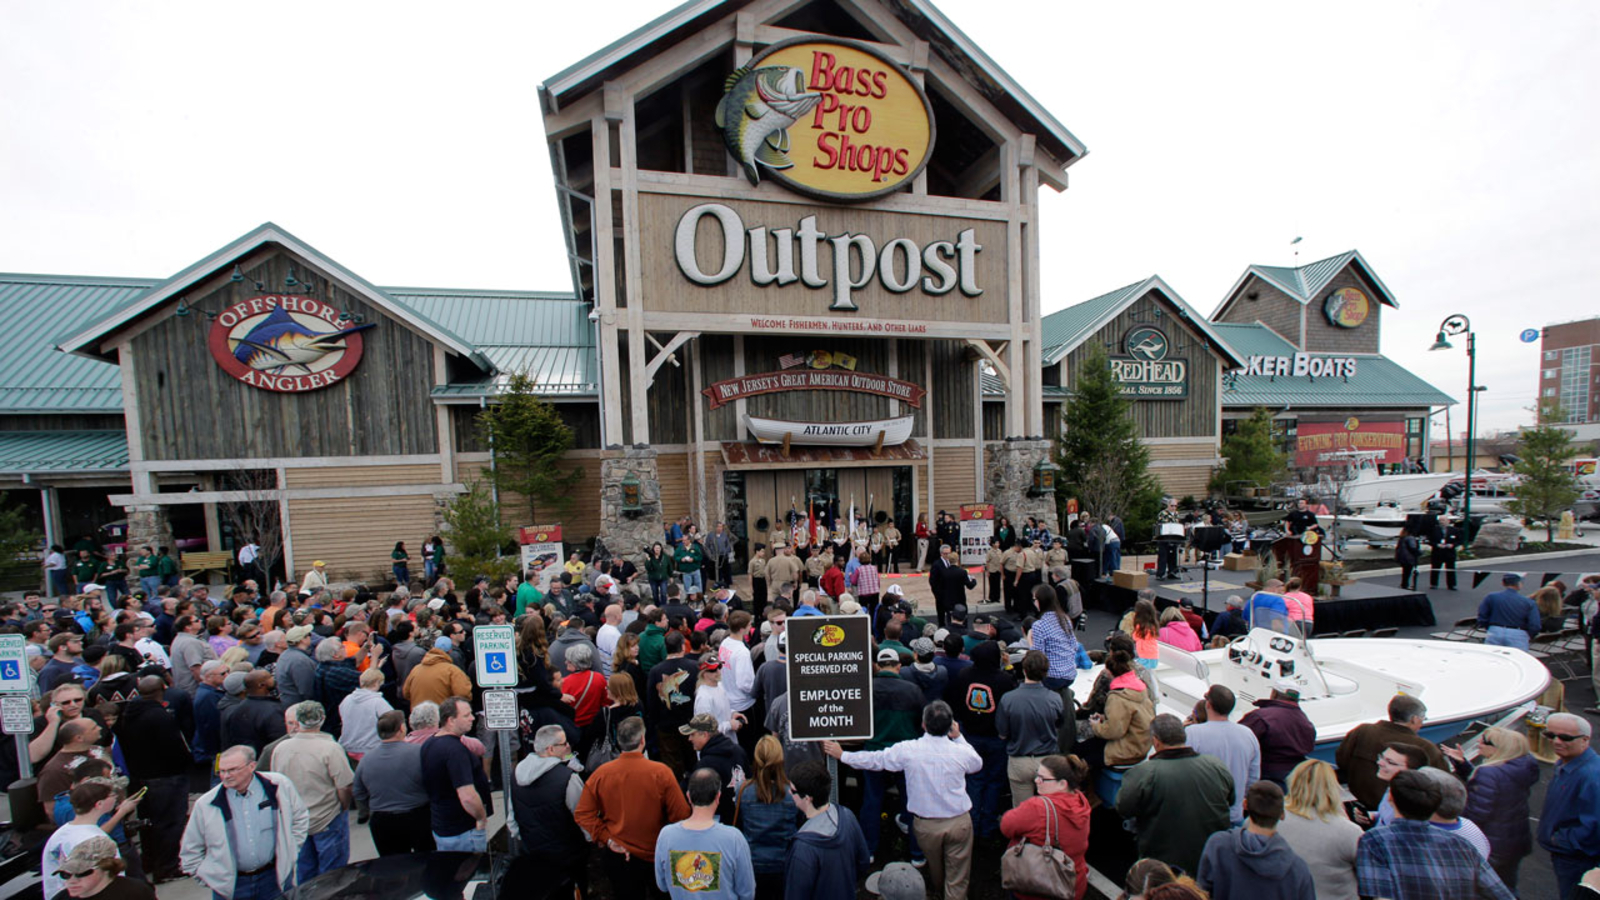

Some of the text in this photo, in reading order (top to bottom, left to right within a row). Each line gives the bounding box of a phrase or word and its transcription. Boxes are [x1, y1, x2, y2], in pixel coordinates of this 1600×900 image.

[807, 50, 887, 99] Bass
[811, 93, 872, 133] Pro
[813, 131, 909, 183] Shops
[674, 203, 984, 311] Outpost
[219, 296, 350, 330] OFFSHORE
[750, 318, 786, 329] WELCOME
[868, 322, 882, 332] AND
[885, 323, 906, 333] OTHER
[908, 324, 926, 333] LIARS
[1109, 360, 1186, 383] REDHEAD
[1293, 352, 1356, 377] BOATS
[239, 368, 341, 391] ANGLER
[719, 372, 911, 398] NEW JERSEY'S GREAT AMERICAN OUTDOOR STORE
[1138, 385, 1163, 395] SINCE
[1164, 386, 1182, 395] 1856
[803, 425, 872, 436] ATLANTIC CITY
[477, 631, 511, 640] RESERVED
[479, 641, 510, 650] PARKING
[795, 651, 864, 663] SPECIAL PARKING
[800, 664, 858, 674] RESERVED FOR
[800, 688, 861, 701] EMPLOYEE
[818, 703, 844, 713] of the
[809, 715, 854, 727] MONTH
